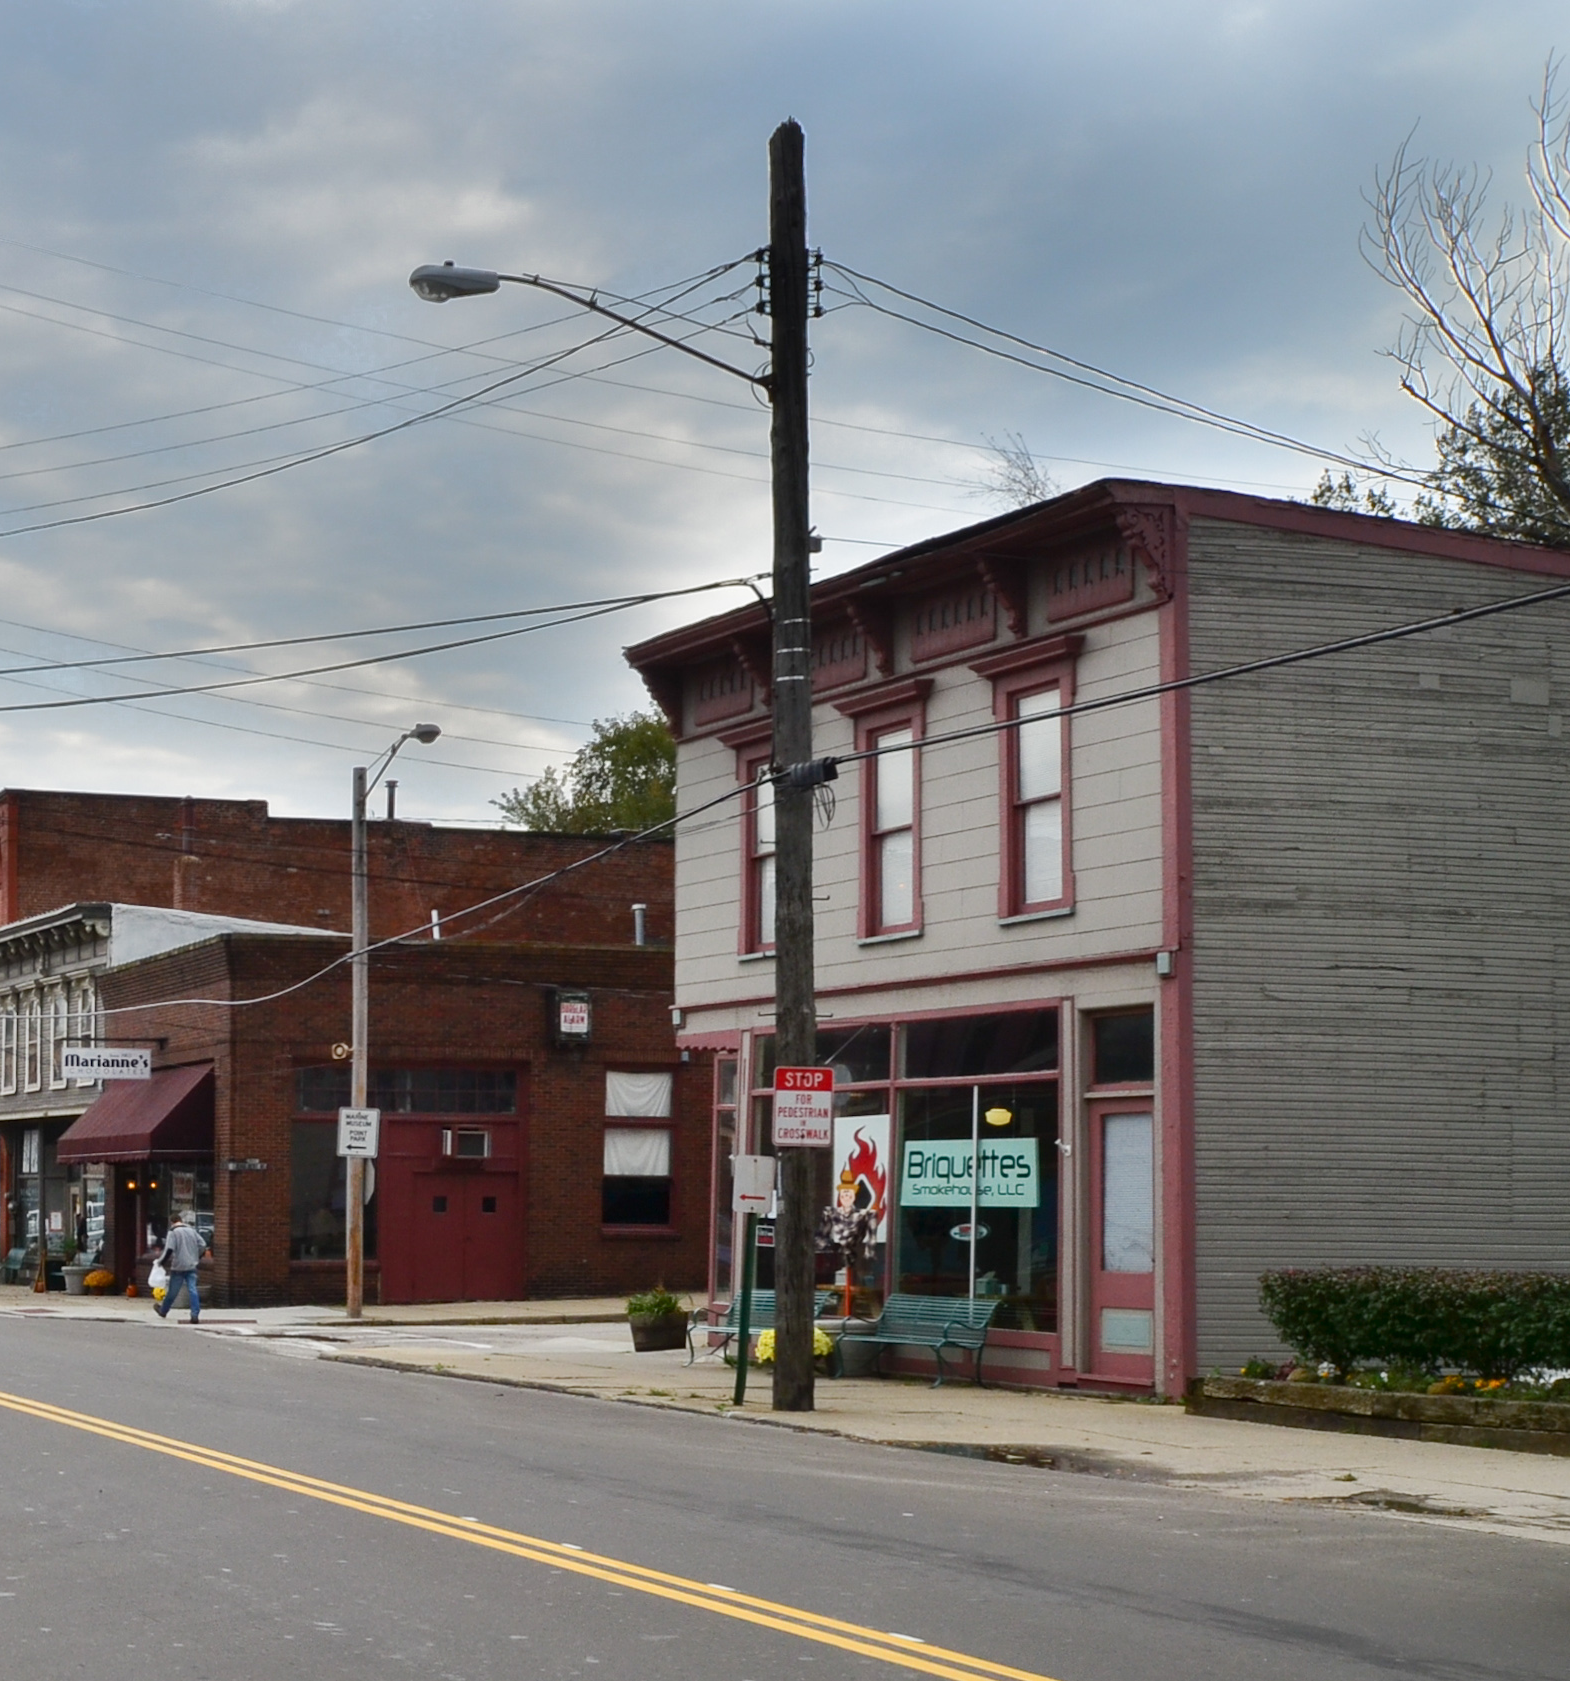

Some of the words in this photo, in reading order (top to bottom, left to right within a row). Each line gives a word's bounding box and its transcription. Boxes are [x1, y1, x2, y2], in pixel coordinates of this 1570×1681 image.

[64, 1054, 149, 1068] Marianne's
[784, 1071, 824, 1088] STOP
[795, 1093, 813, 1105] FOR
[777, 1106, 829, 1118] PEDESTRIAN
[777, 1128, 829, 1140] CROSSWALK
[907, 1149, 1032, 1184] Briquettes
[997, 1183, 1026, 1197] LLC
